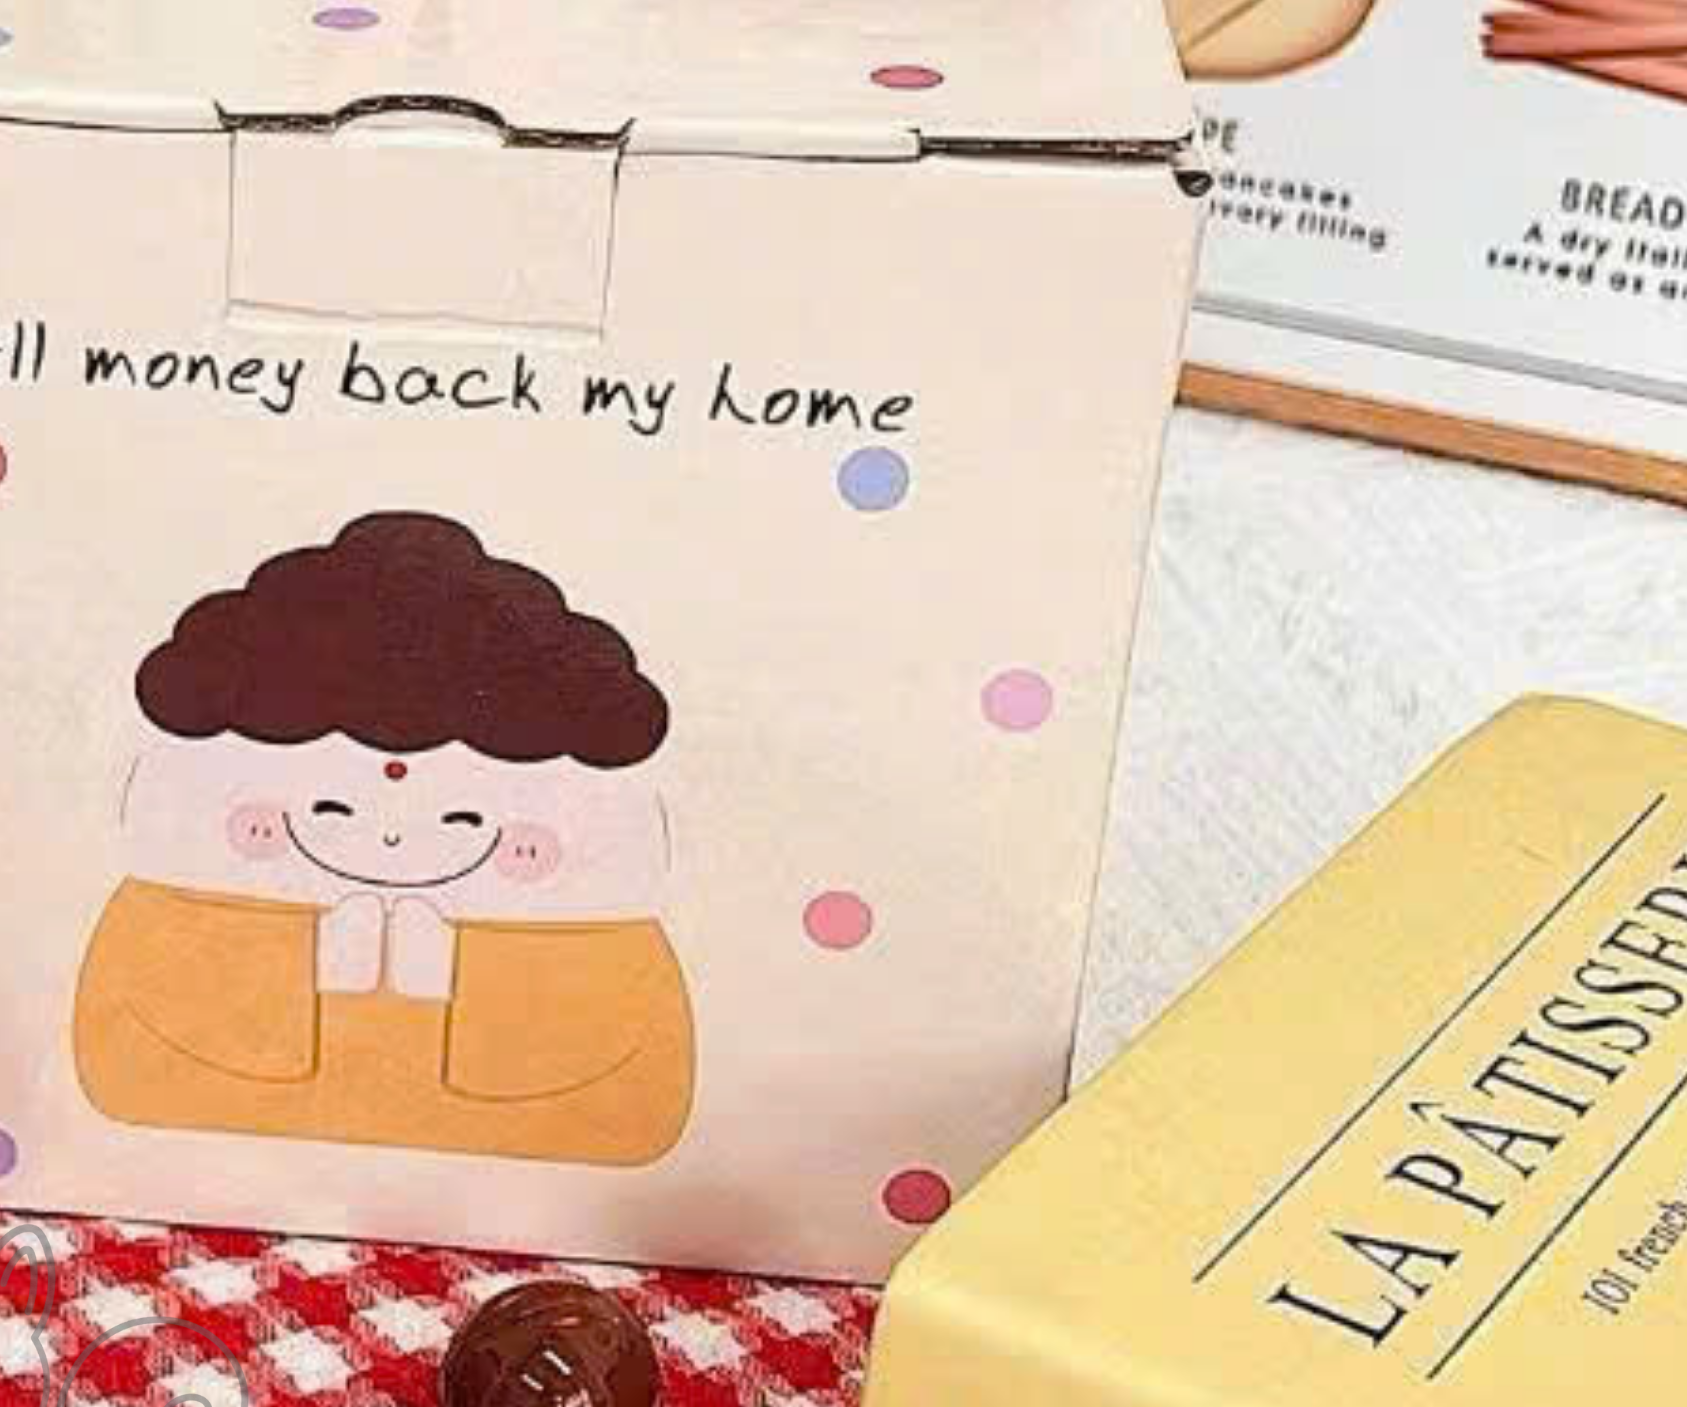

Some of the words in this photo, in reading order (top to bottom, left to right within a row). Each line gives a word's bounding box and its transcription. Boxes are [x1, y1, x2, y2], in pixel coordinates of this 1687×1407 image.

[1218, 170, 1352, 212] ancakes
[1561, 177, 1686, 232] BREAD
[1522, 220, 1544, 244] A
[1560, 227, 1610, 260] dry
[1486, 246, 1596, 287] served
[83, 345, 306, 415] money
[339, 338, 542, 414] back
[582, 373, 677, 436] my
[708, 361, 916, 433] home
[1265, 1226, 1462, 1350] LA
